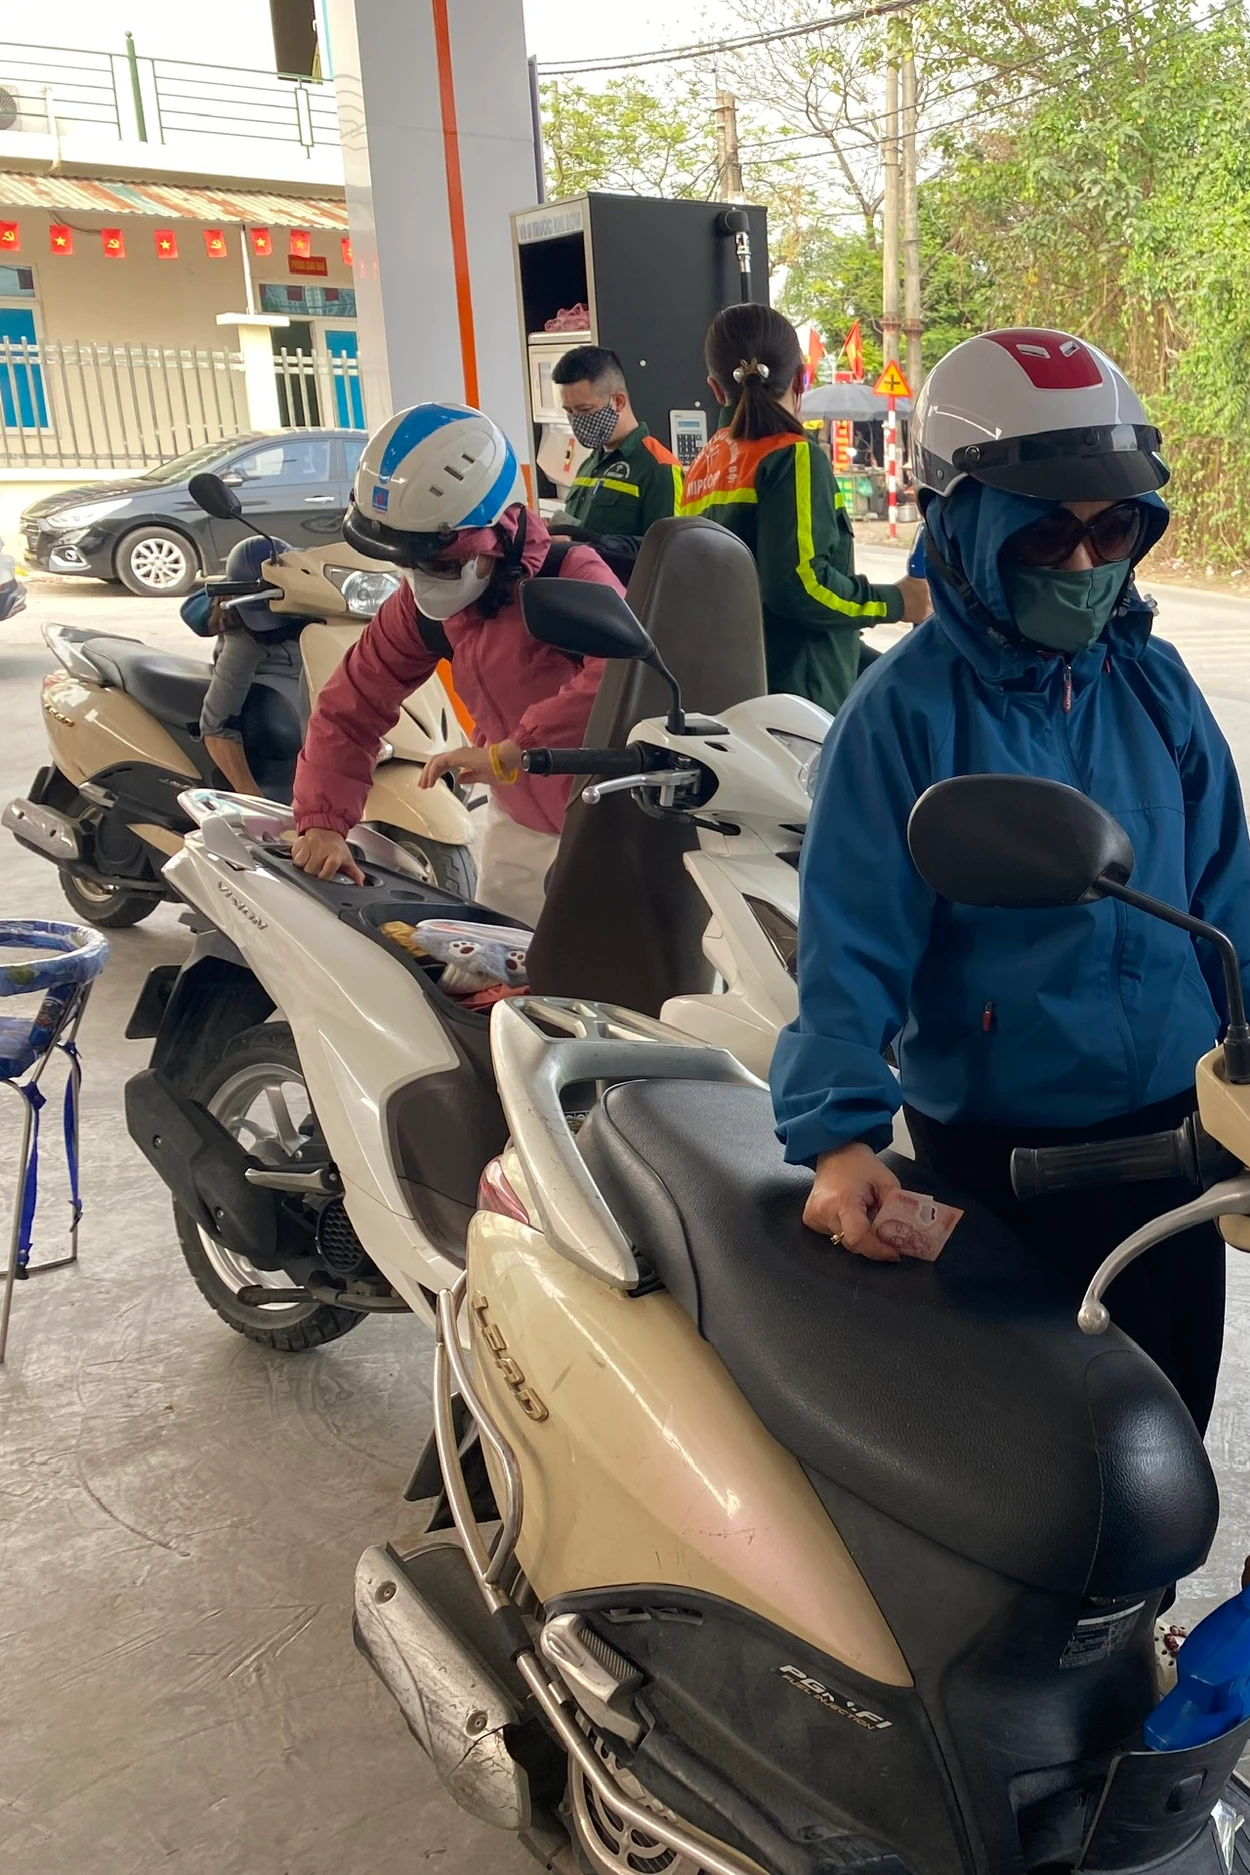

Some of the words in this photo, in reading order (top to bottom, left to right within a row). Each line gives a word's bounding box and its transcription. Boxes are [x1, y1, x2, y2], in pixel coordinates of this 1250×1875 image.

[218, 881, 268, 930] VISION
[471, 1294, 550, 1423] LEAD
[782, 1674, 812, 1696] FUEL
[814, 1693, 877, 1731] INJECTION
